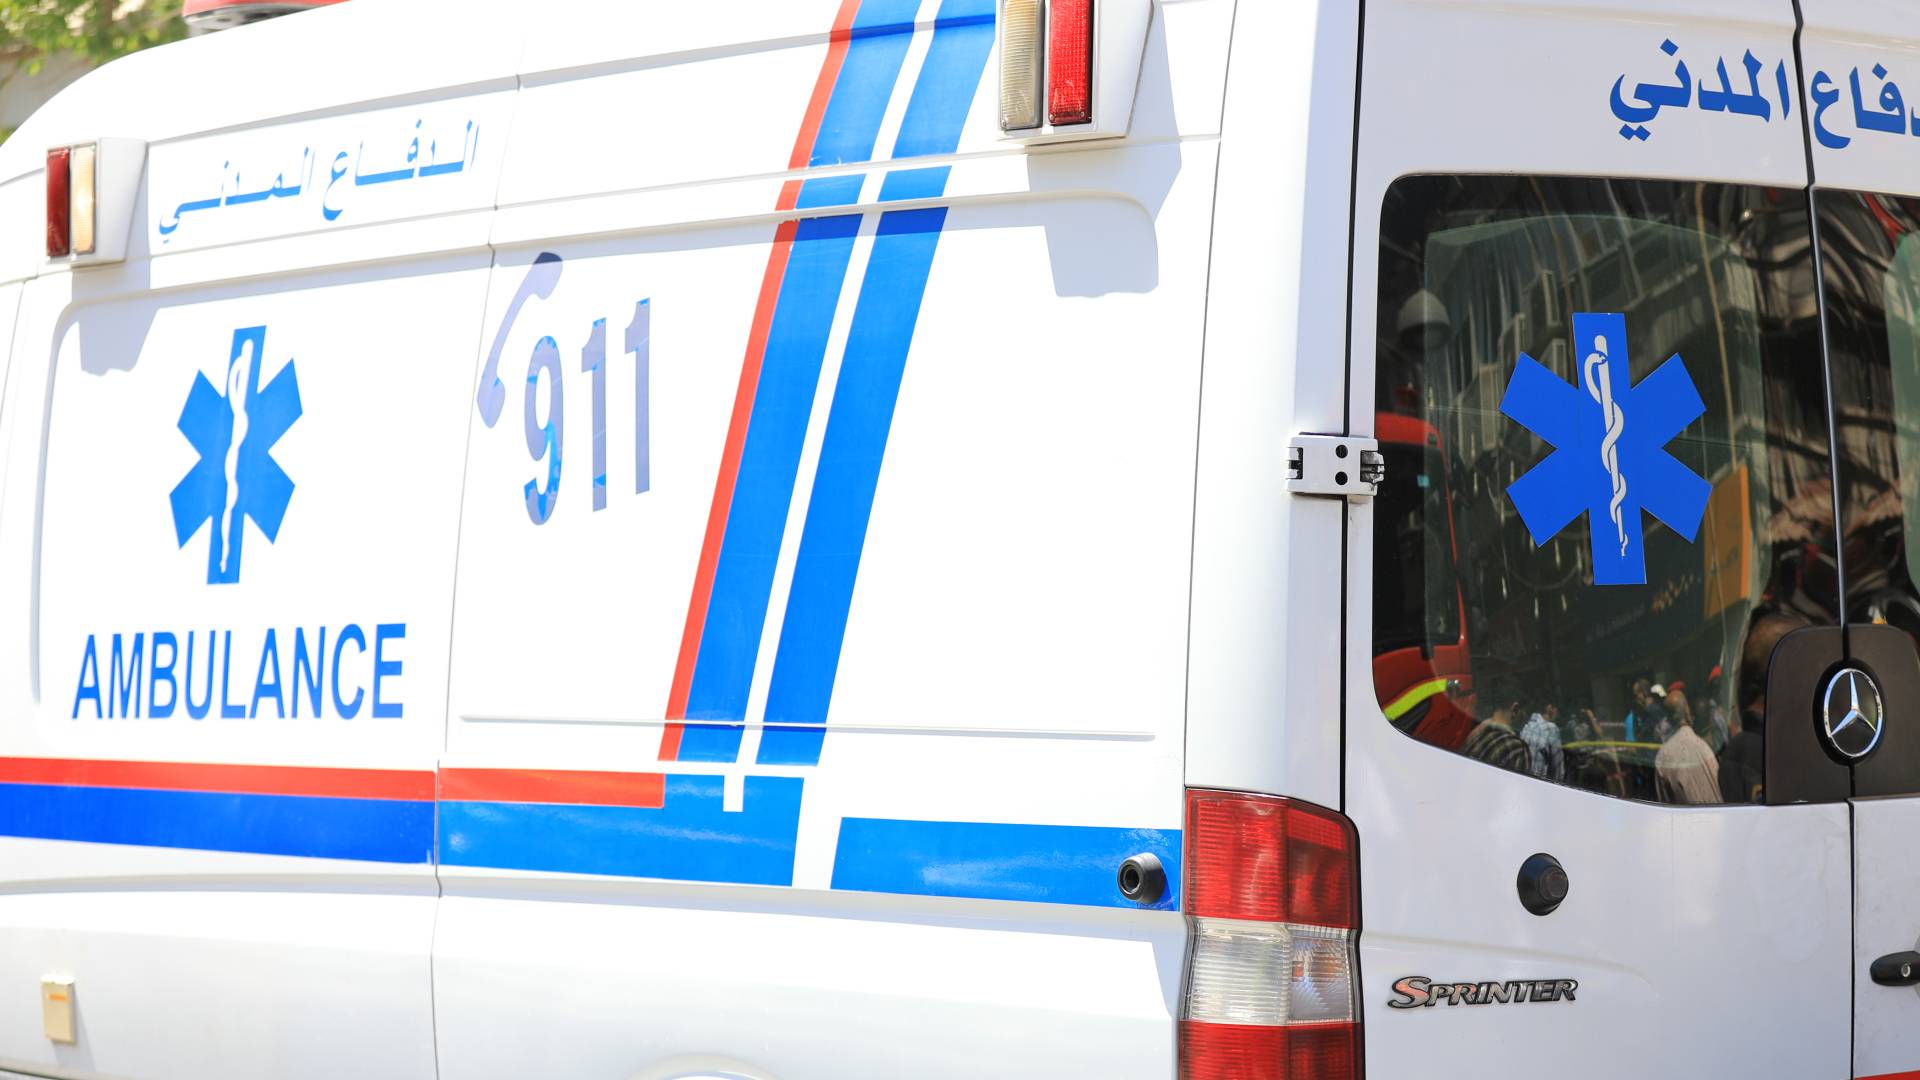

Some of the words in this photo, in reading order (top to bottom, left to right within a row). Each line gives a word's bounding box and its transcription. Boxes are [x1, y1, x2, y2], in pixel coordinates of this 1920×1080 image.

[1609, 38, 1790, 142] المدني
[159, 145, 316, 244] المدني
[323, 118, 480, 221] الدفاع
[524, 296, 650, 526] 911
[72, 623, 406, 720] AMBULANCE
[1387, 975, 1579, 1009] SPRINTER
